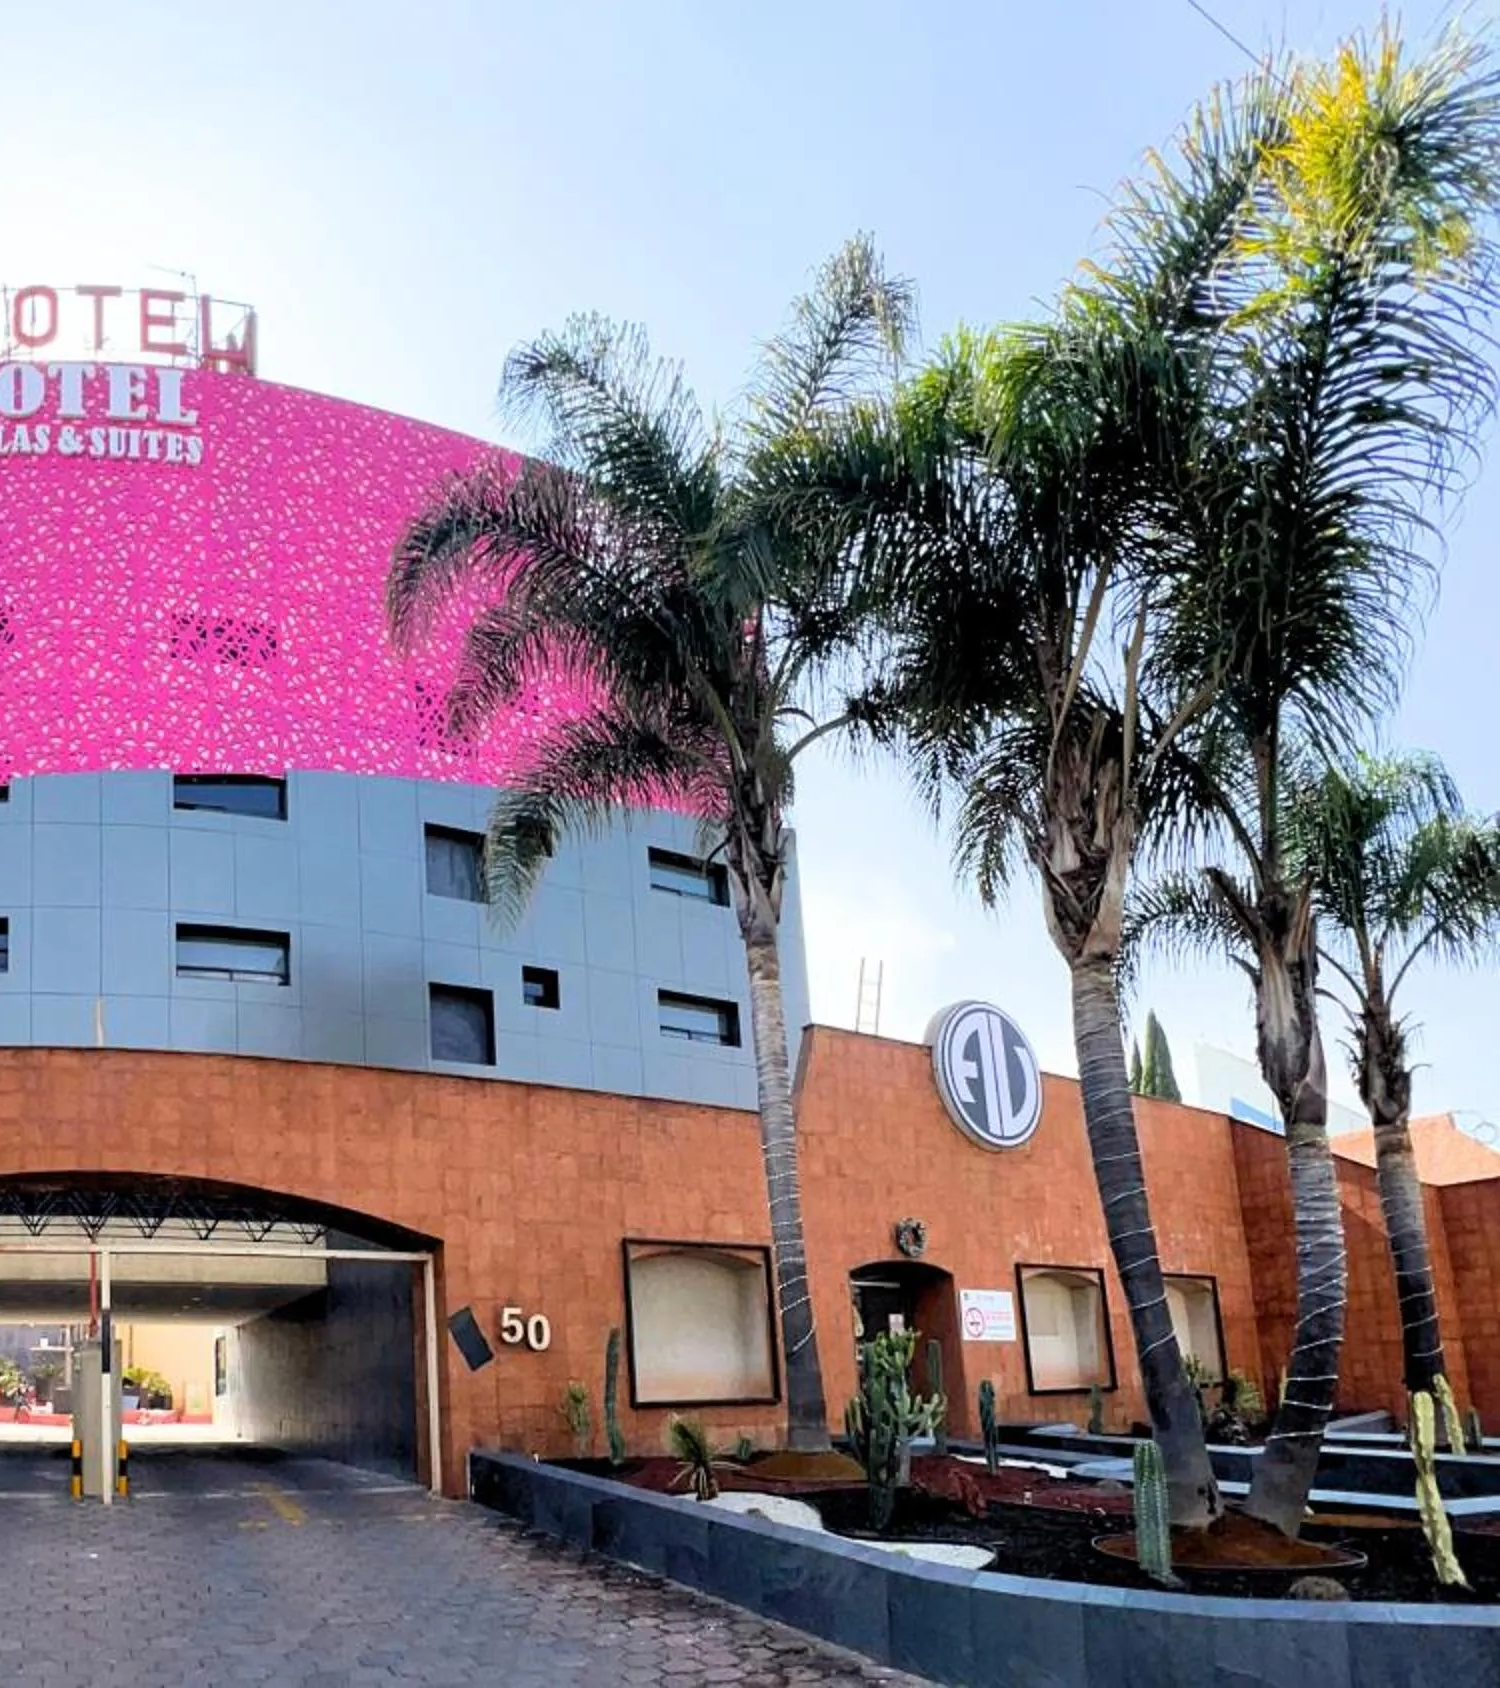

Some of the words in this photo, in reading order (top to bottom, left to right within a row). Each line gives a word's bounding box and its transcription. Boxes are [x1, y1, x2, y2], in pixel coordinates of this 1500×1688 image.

[57, 426, 84, 453] &
[88, 428, 204, 465] SUITES
[501, 1307, 551, 1351] 50
